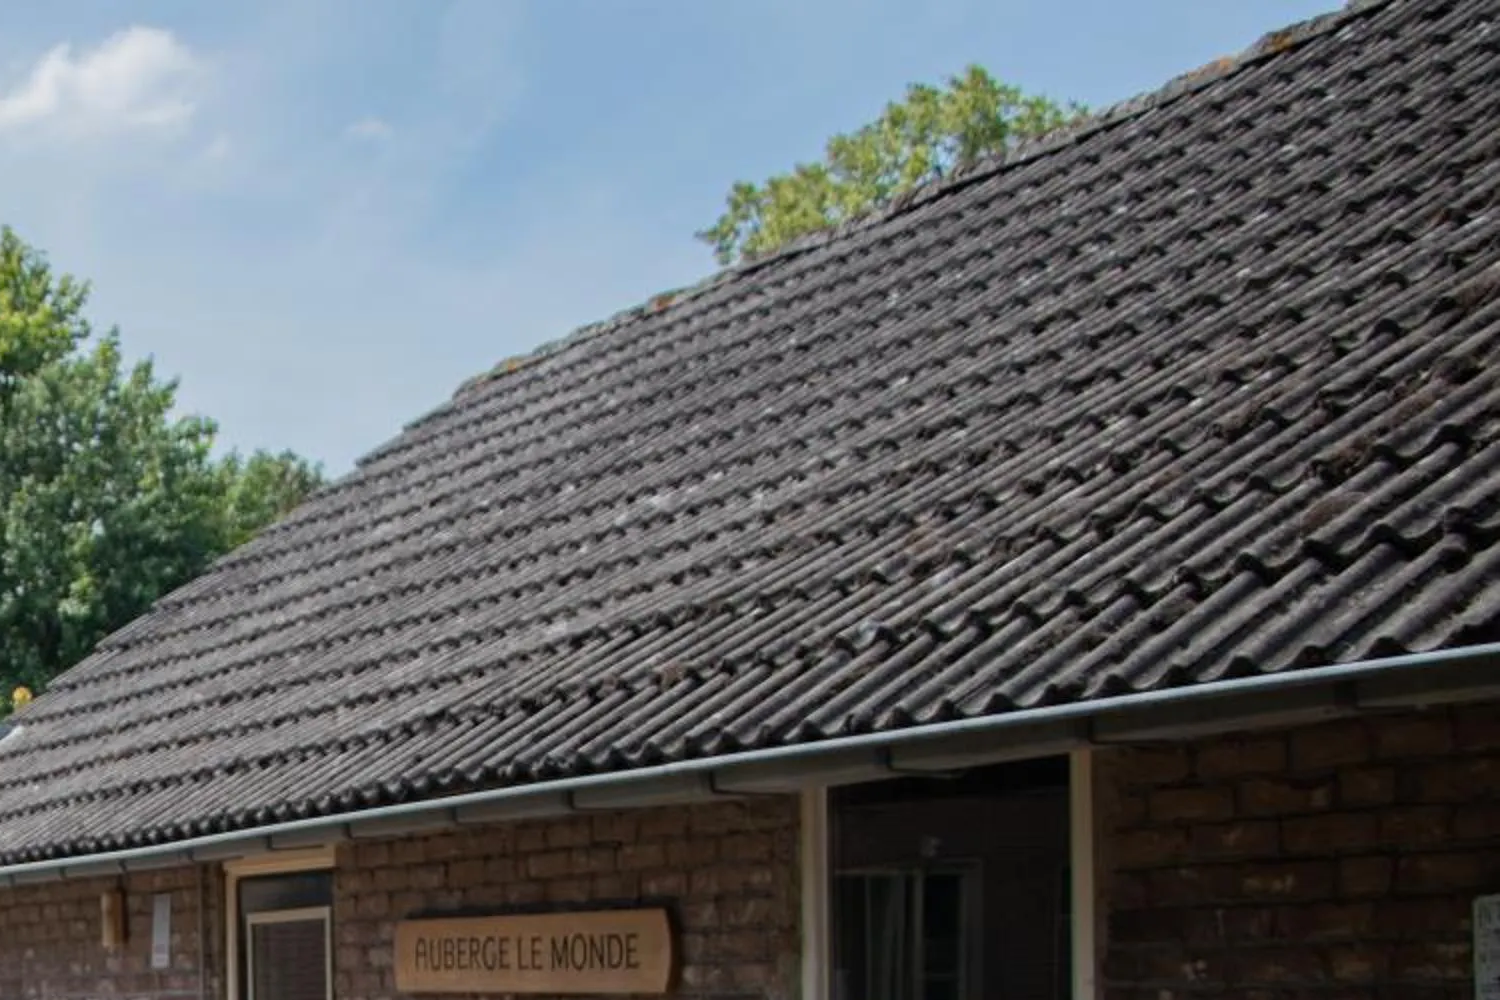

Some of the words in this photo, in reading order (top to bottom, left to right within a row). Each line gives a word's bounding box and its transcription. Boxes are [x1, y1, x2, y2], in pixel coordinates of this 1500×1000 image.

[414, 936, 510, 971] AUBERGE
[517, 935, 543, 970] LE
[550, 932, 640, 969] MONDE
